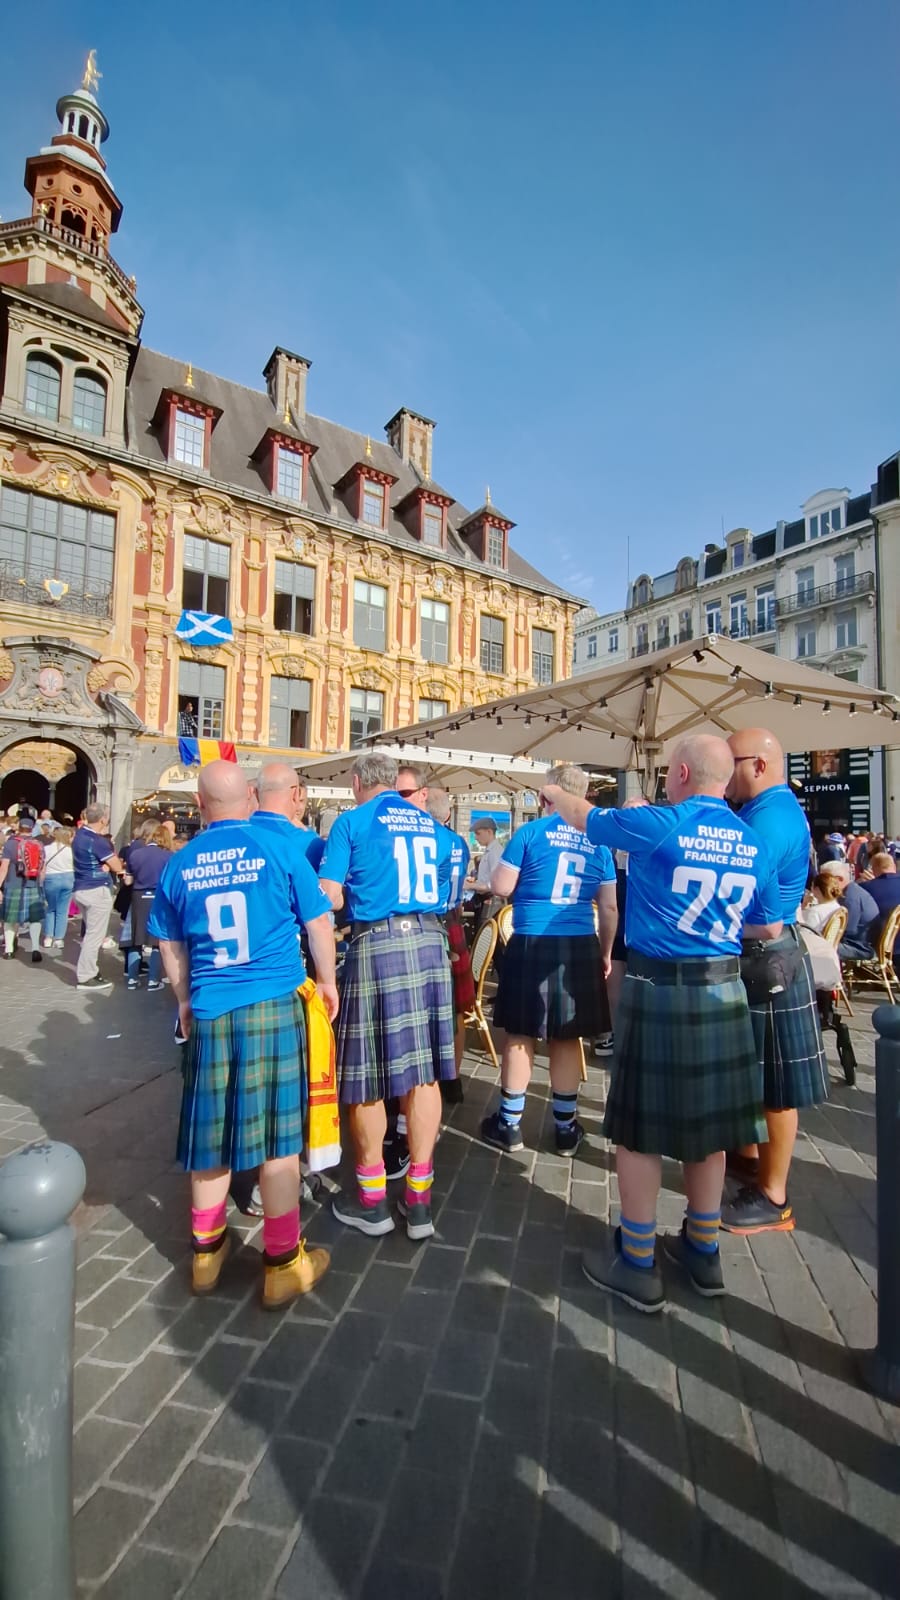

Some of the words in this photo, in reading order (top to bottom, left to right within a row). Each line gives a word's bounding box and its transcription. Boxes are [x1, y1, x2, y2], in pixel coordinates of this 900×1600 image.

[804, 783, 850, 793] SEPHORA
[386, 807, 422, 817] RUGBY
[378, 816, 418, 825] WORLD
[419, 817, 435, 827] CUP
[387, 824, 419, 833] FRANCE
[420, 825, 436, 834] 2023
[545, 831, 581, 843] WORLD
[697, 825, 743, 842] RUGBY
[197, 846, 247, 865] RUGBY
[550, 840, 579, 851] FRANCE
[579, 845, 595, 854] 2023
[678, 835, 732, 854] WORLD
[735, 843, 758, 858] CUP
[684, 850, 729, 865] FRANCE
[730, 856, 753, 868] 2023
[181, 863, 233, 881] WORLD
[236, 857, 266, 872] CUP
[393, 836, 439, 904] 16
[550, 851, 586, 905] 6
[187, 876, 230, 892] FRANCE
[231, 872, 259, 885] 2023
[671, 865, 757, 944] 23
[205, 890, 251, 969] 9
